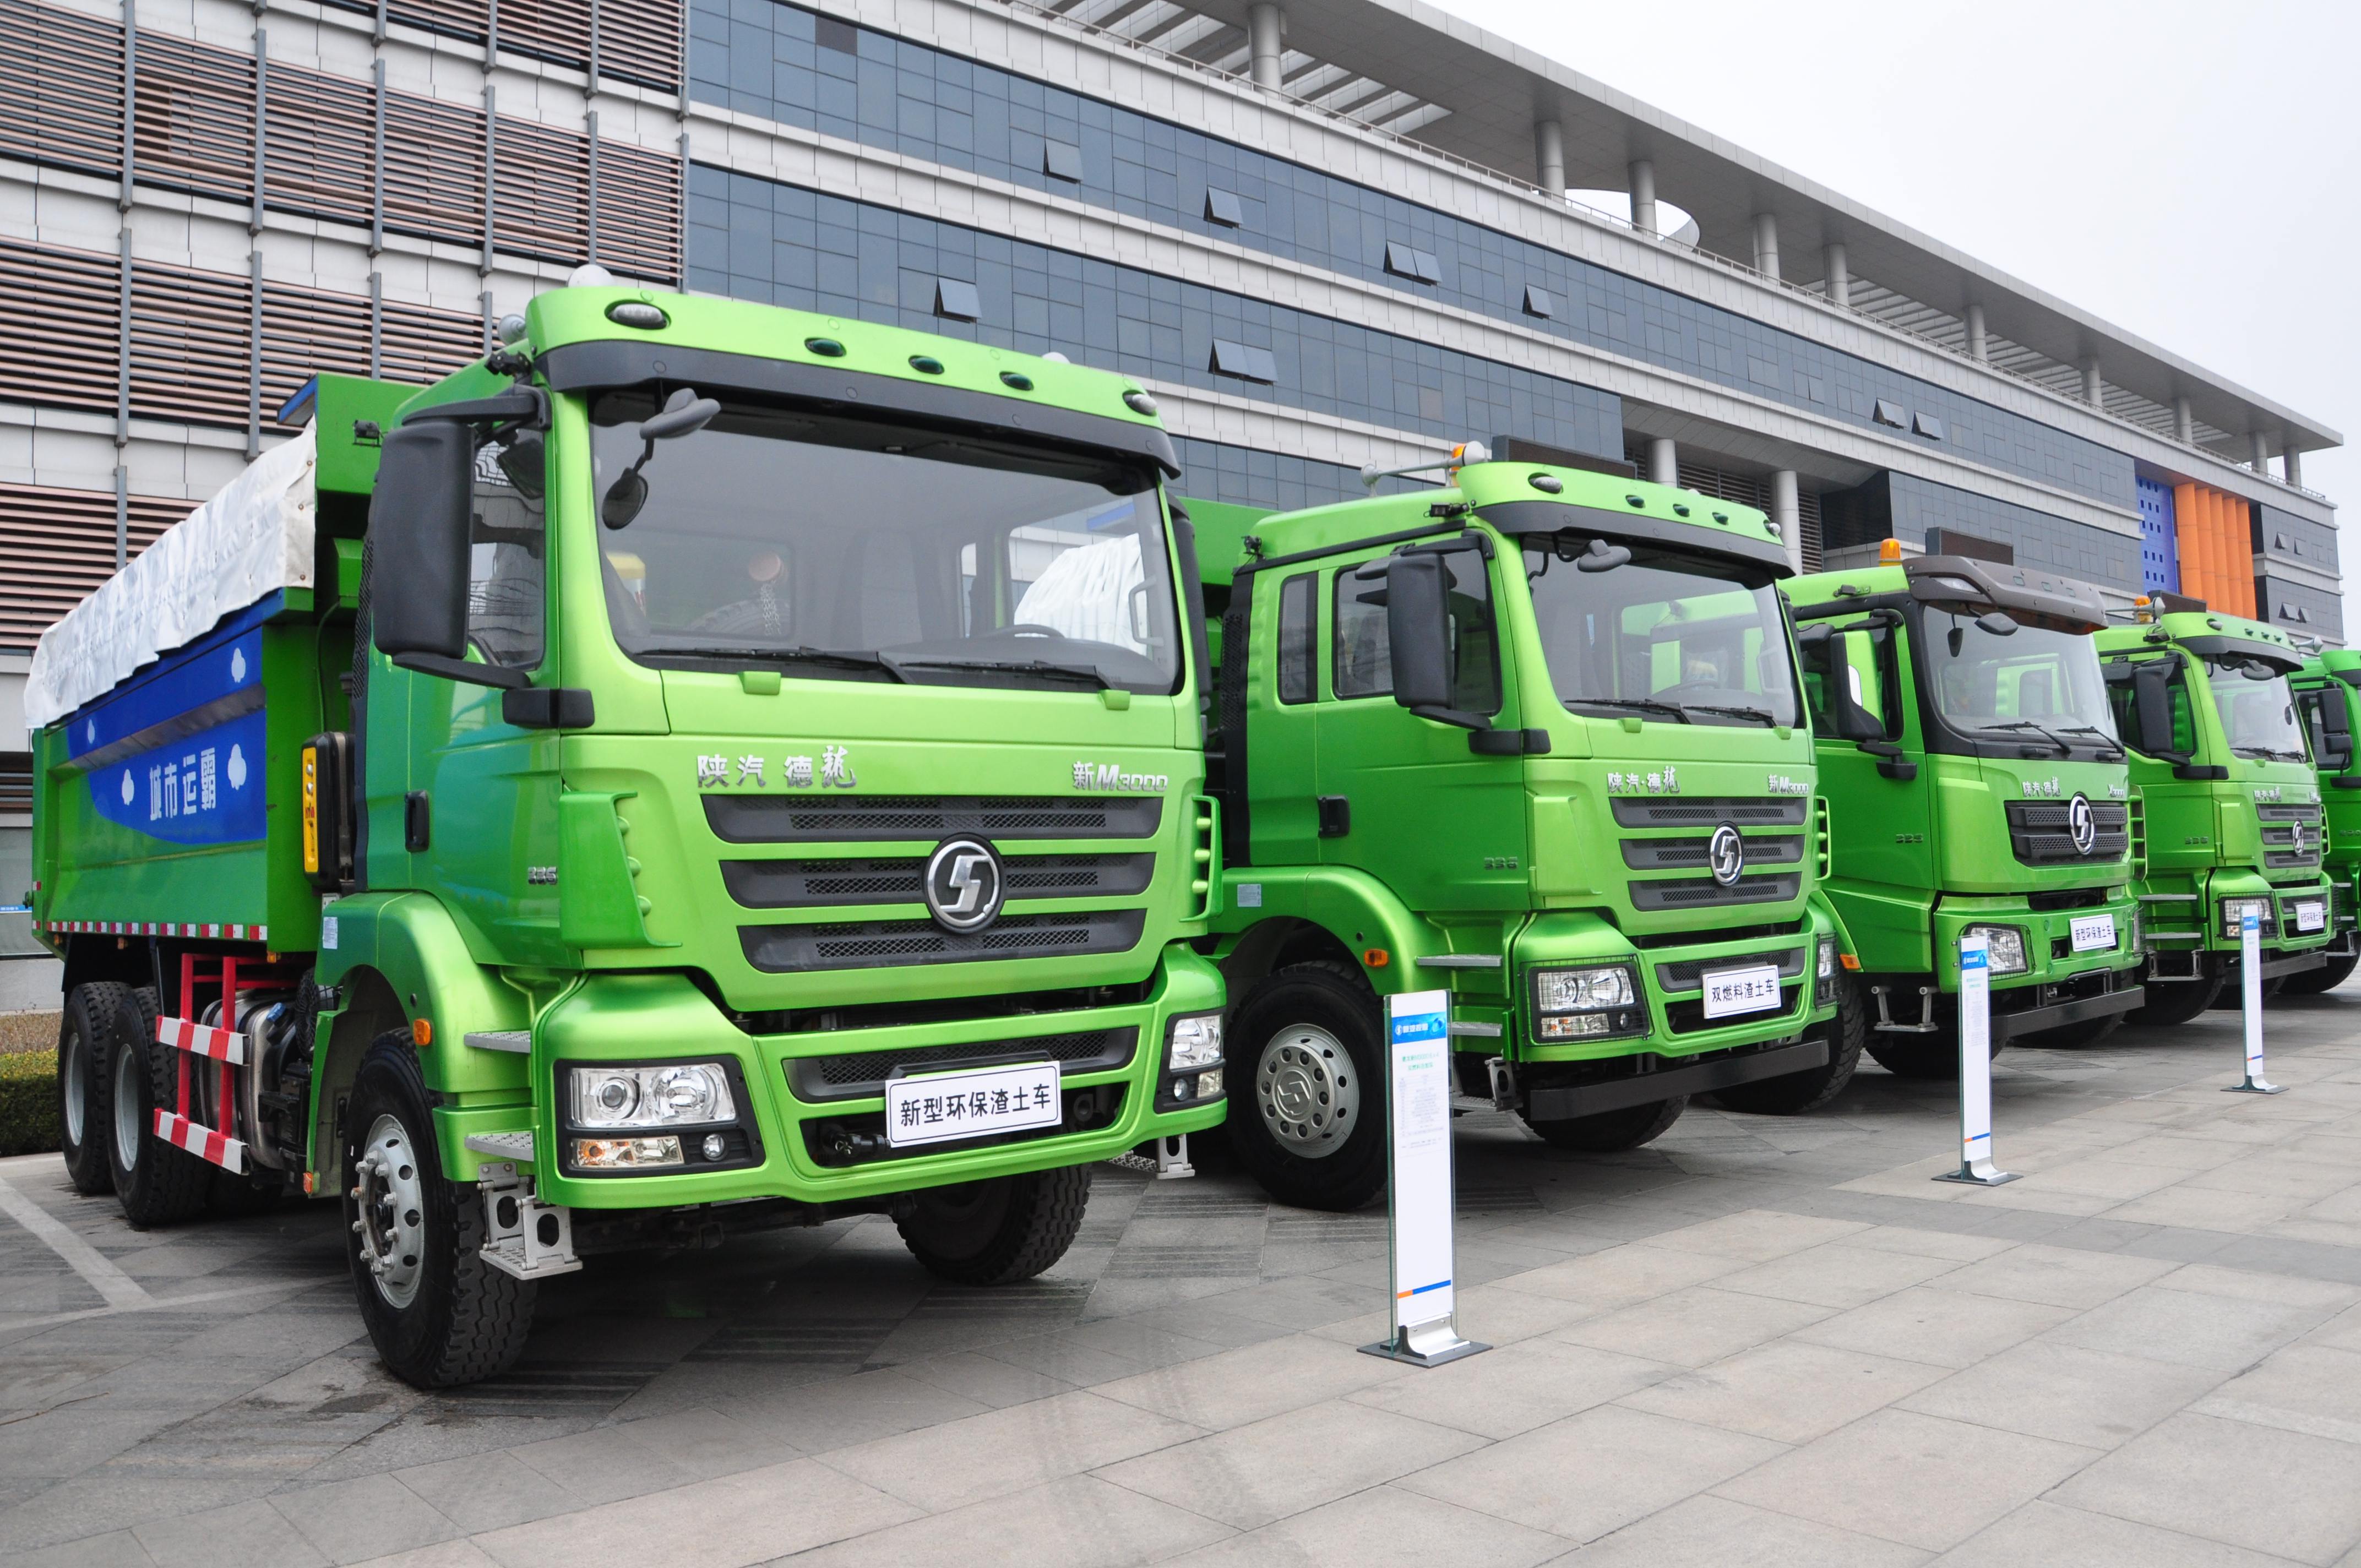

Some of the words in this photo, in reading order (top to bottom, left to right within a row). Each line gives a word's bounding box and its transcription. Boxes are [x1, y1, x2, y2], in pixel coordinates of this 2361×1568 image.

[150, 747, 216, 821] 城市运霸
[1073, 761, 1168, 792] 新M3000
[1712, 978, 1774, 1003] 双燃料渣土车
[900, 1083, 1051, 1127] 新型环保渣土车
